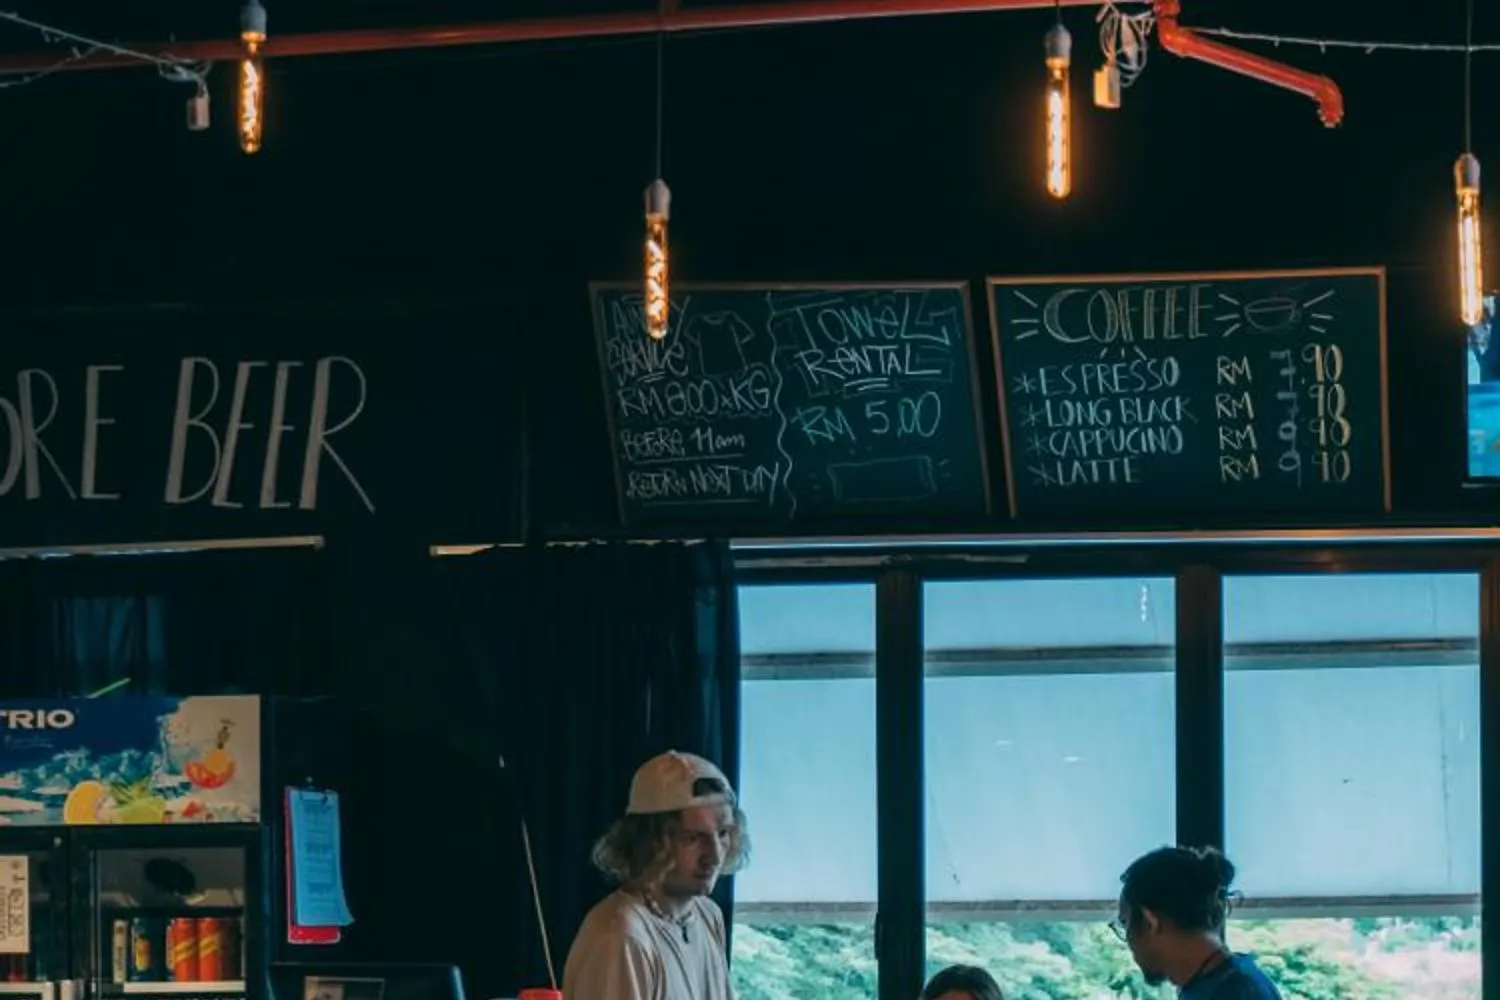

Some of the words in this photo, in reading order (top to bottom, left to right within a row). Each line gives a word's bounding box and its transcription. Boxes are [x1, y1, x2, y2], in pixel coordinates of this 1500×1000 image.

[1043, 283, 1213, 343] COFFEE
[1039, 356, 1180, 395] ESPRESSO
[1217, 355, 1252, 385] RM
[790, 405, 856, 445] RM
[1045, 398, 1112, 427] LONG
[1119, 394, 1199, 424] BLACK
[1215, 391, 1255, 420] RM
[164, 355, 376, 514] BEER
[1049, 424, 1183, 458] CAPPUCINO
[1218, 424, 1258, 450] RM
[1057, 456, 1142, 487] LATTE
[1220, 452, 1260, 484] RM
[0, 708, 75, 729] RIO
